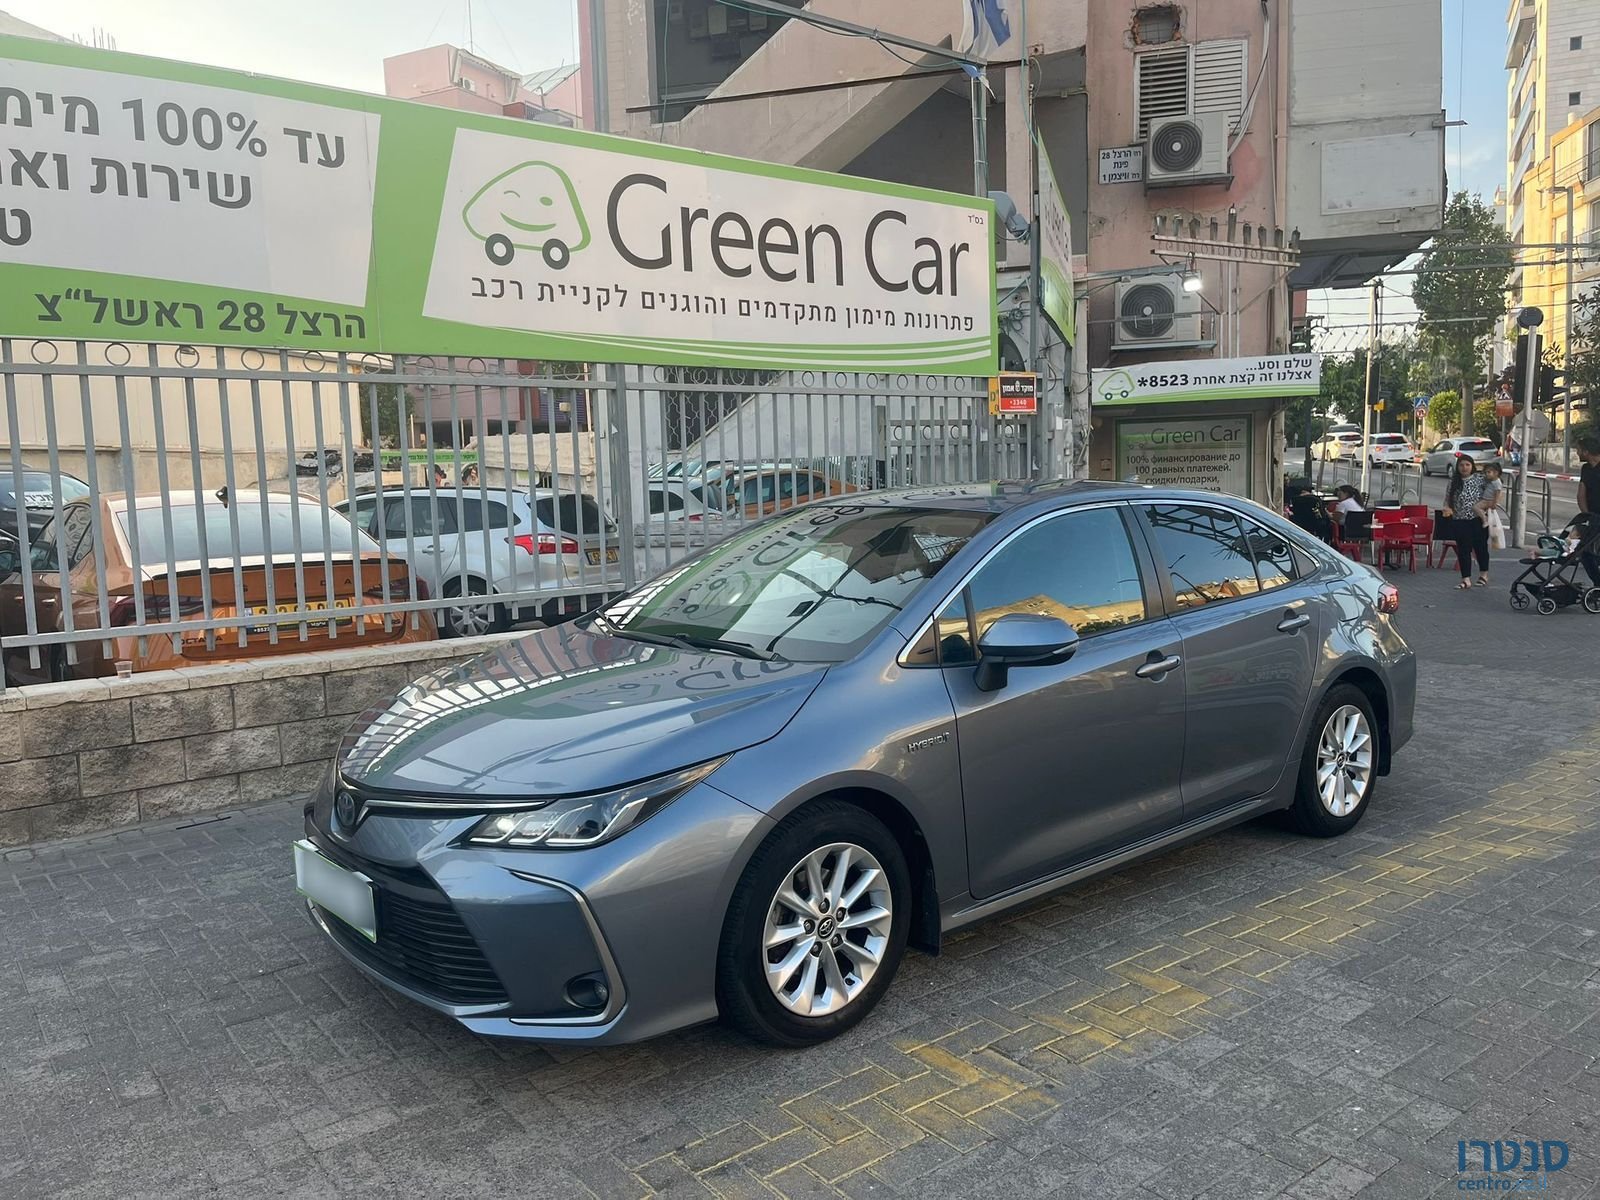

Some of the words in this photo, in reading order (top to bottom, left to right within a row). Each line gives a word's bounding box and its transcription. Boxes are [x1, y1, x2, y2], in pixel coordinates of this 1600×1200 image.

[121, 98, 268, 158] 100%
[283, 127, 346, 169] עד
[1101, 152, 1110, 160] 28
[1112, 149, 1131, 159] הרצל
[0, 148, 70, 191] וא
[1113, 161, 1128, 169] פינת
[89, 157, 251, 210] שירות
[606, 173, 844, 286] Green
[864, 210, 970, 297] Car
[471, 276, 524, 300] רכב
[537, 283, 629, 312] לקניית
[640, 290, 726, 315] והוגנים
[738, 298, 837, 326] מתקדמים
[216, 299, 266, 333] 28
[276, 302, 367, 339] הרצל
[845, 306, 896, 329] מימון
[904, 311, 974, 332] פתרונות
[1284, 358, 1313, 370] שלם
[1193, 375, 1226, 386] אחרת
[1229, 372, 1256, 384] קצת
[1259, 372, 1273, 382] זה
[1277, 370, 1313, 381] אצלנו
[1150, 428, 1205, 444] Green
[1210, 425, 1241, 442] Car
[1126, 455, 1150, 465] 100%
[1151, 454, 1228, 465] финансирование
[1228, 453, 1241, 463] до
[1135, 466, 1150, 475] 100
[1152, 466, 1185, 476] равных
